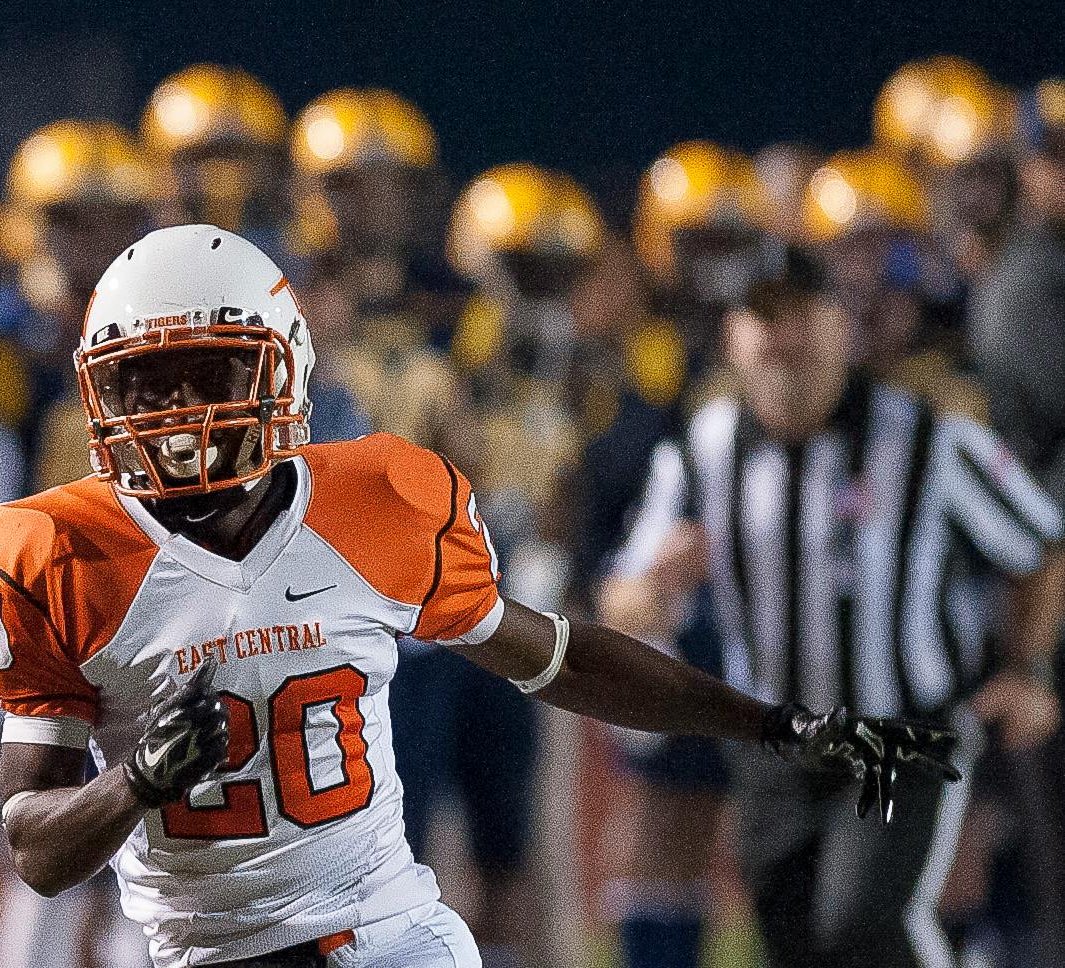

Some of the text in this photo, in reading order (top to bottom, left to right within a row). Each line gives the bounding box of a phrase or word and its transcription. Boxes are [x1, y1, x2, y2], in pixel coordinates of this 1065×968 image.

[147, 314, 188, 329] TIGERS
[175, 622, 327, 675] EAST CENTRAL
[159, 662, 375, 841] 20
